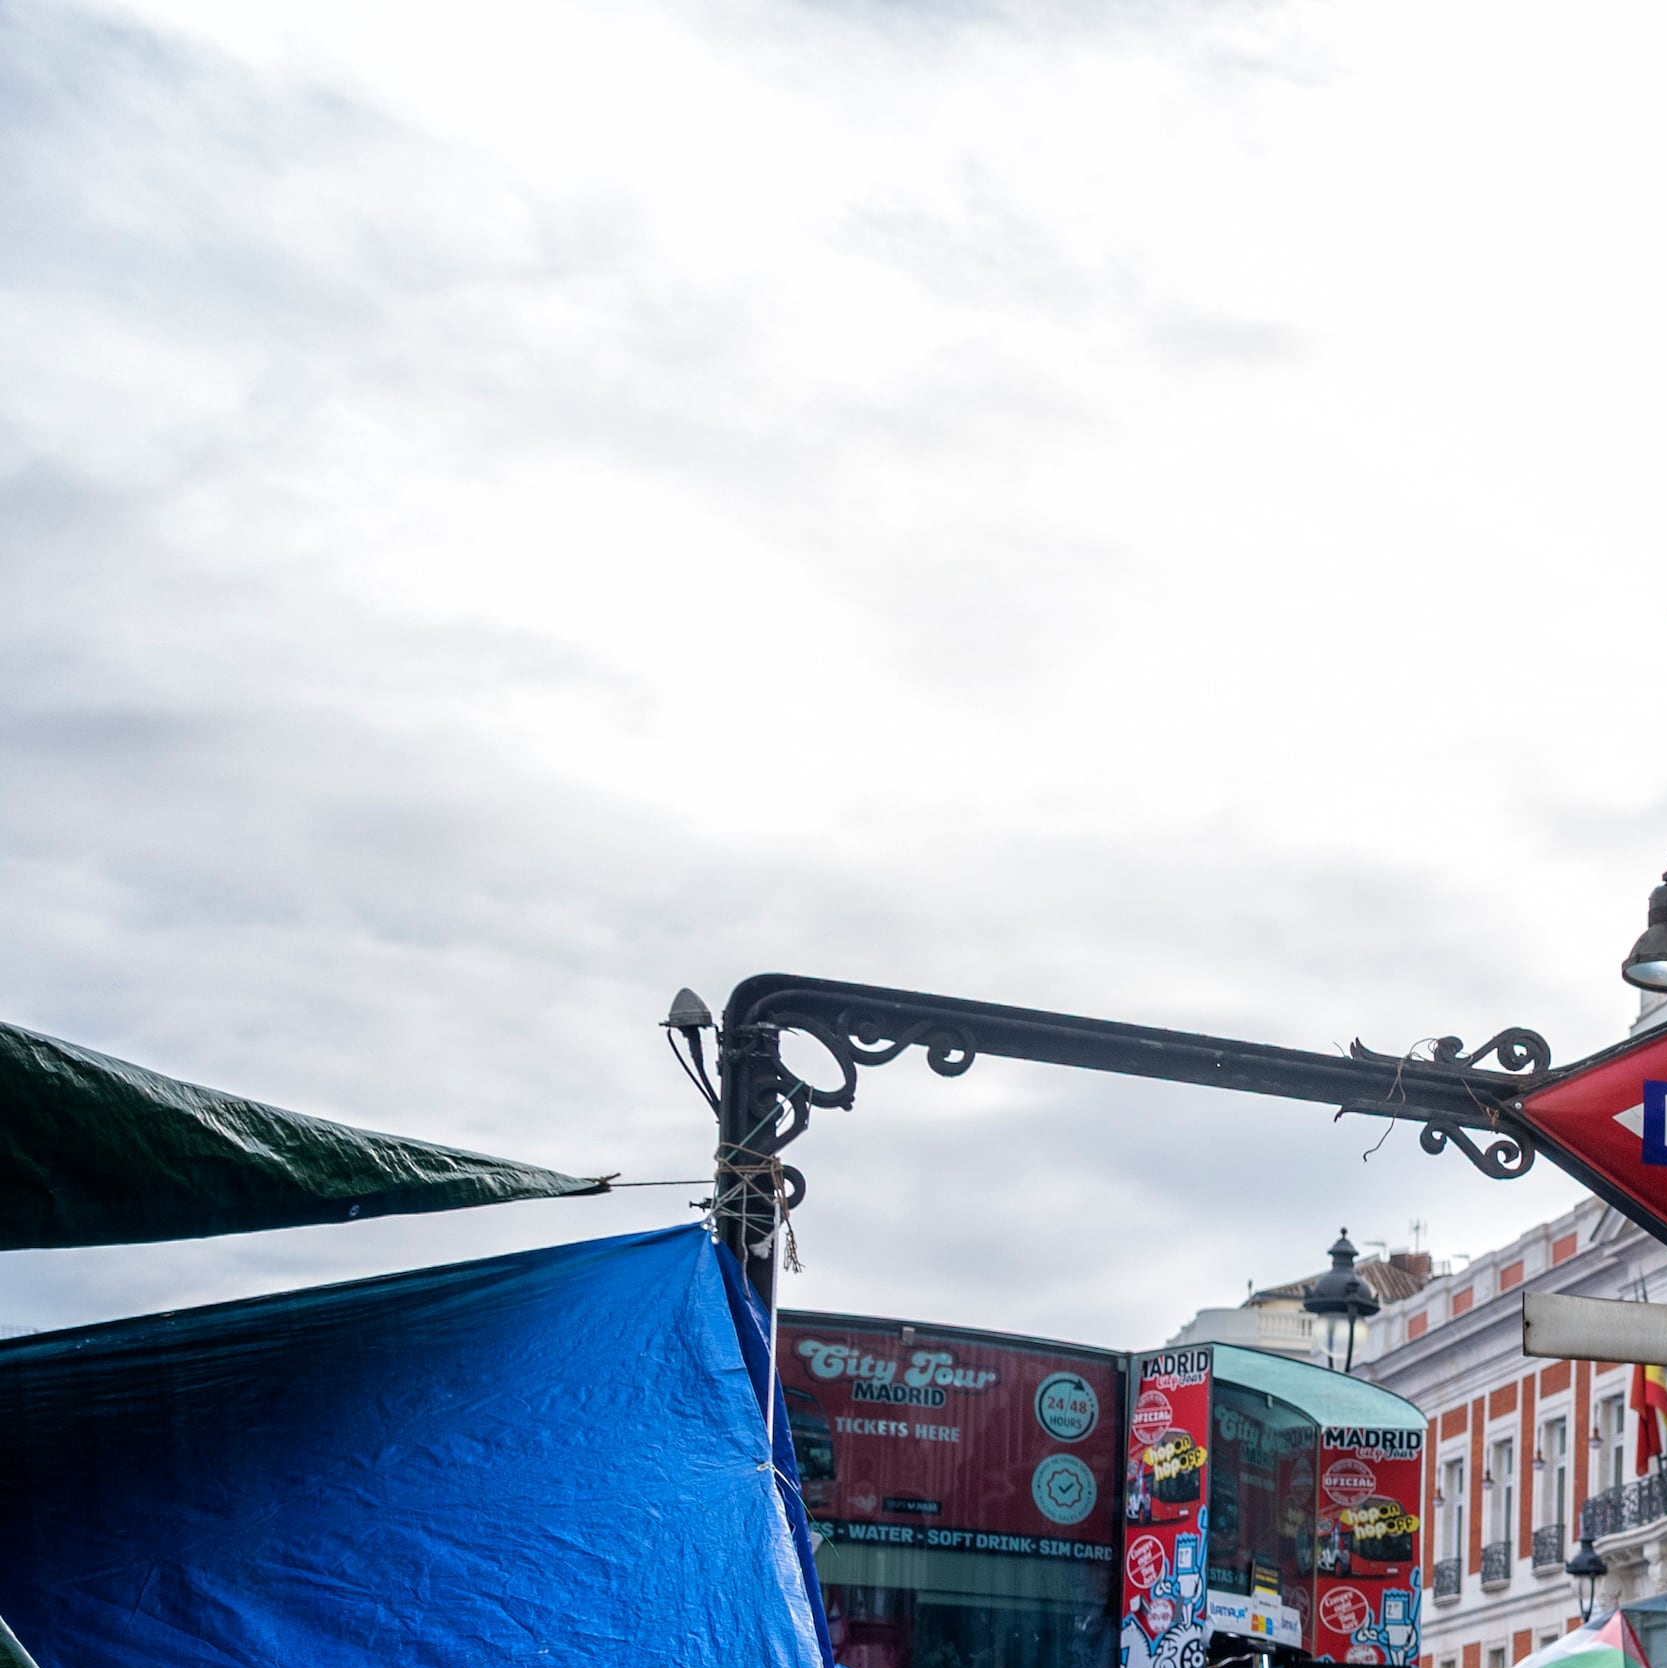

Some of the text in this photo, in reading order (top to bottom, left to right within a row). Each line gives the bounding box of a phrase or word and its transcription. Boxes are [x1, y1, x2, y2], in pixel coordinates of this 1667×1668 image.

[798, 1340, 997, 1390] City Tour
[853, 1380, 947, 1408] MADRID
[835, 1417, 960, 1443] TICKETS HERE
[1049, 1415, 1082, 1430] HOURS
[1326, 1429, 1420, 1449] MADRID
[1325, 1477, 1374, 1487] OFICIAL
[849, 1524, 913, 1543] WATER
[927, 1531, 974, 1548] SOFT
[1040, 1540, 1072, 1556] SIM
[1074, 1543, 1112, 1560] CARD
